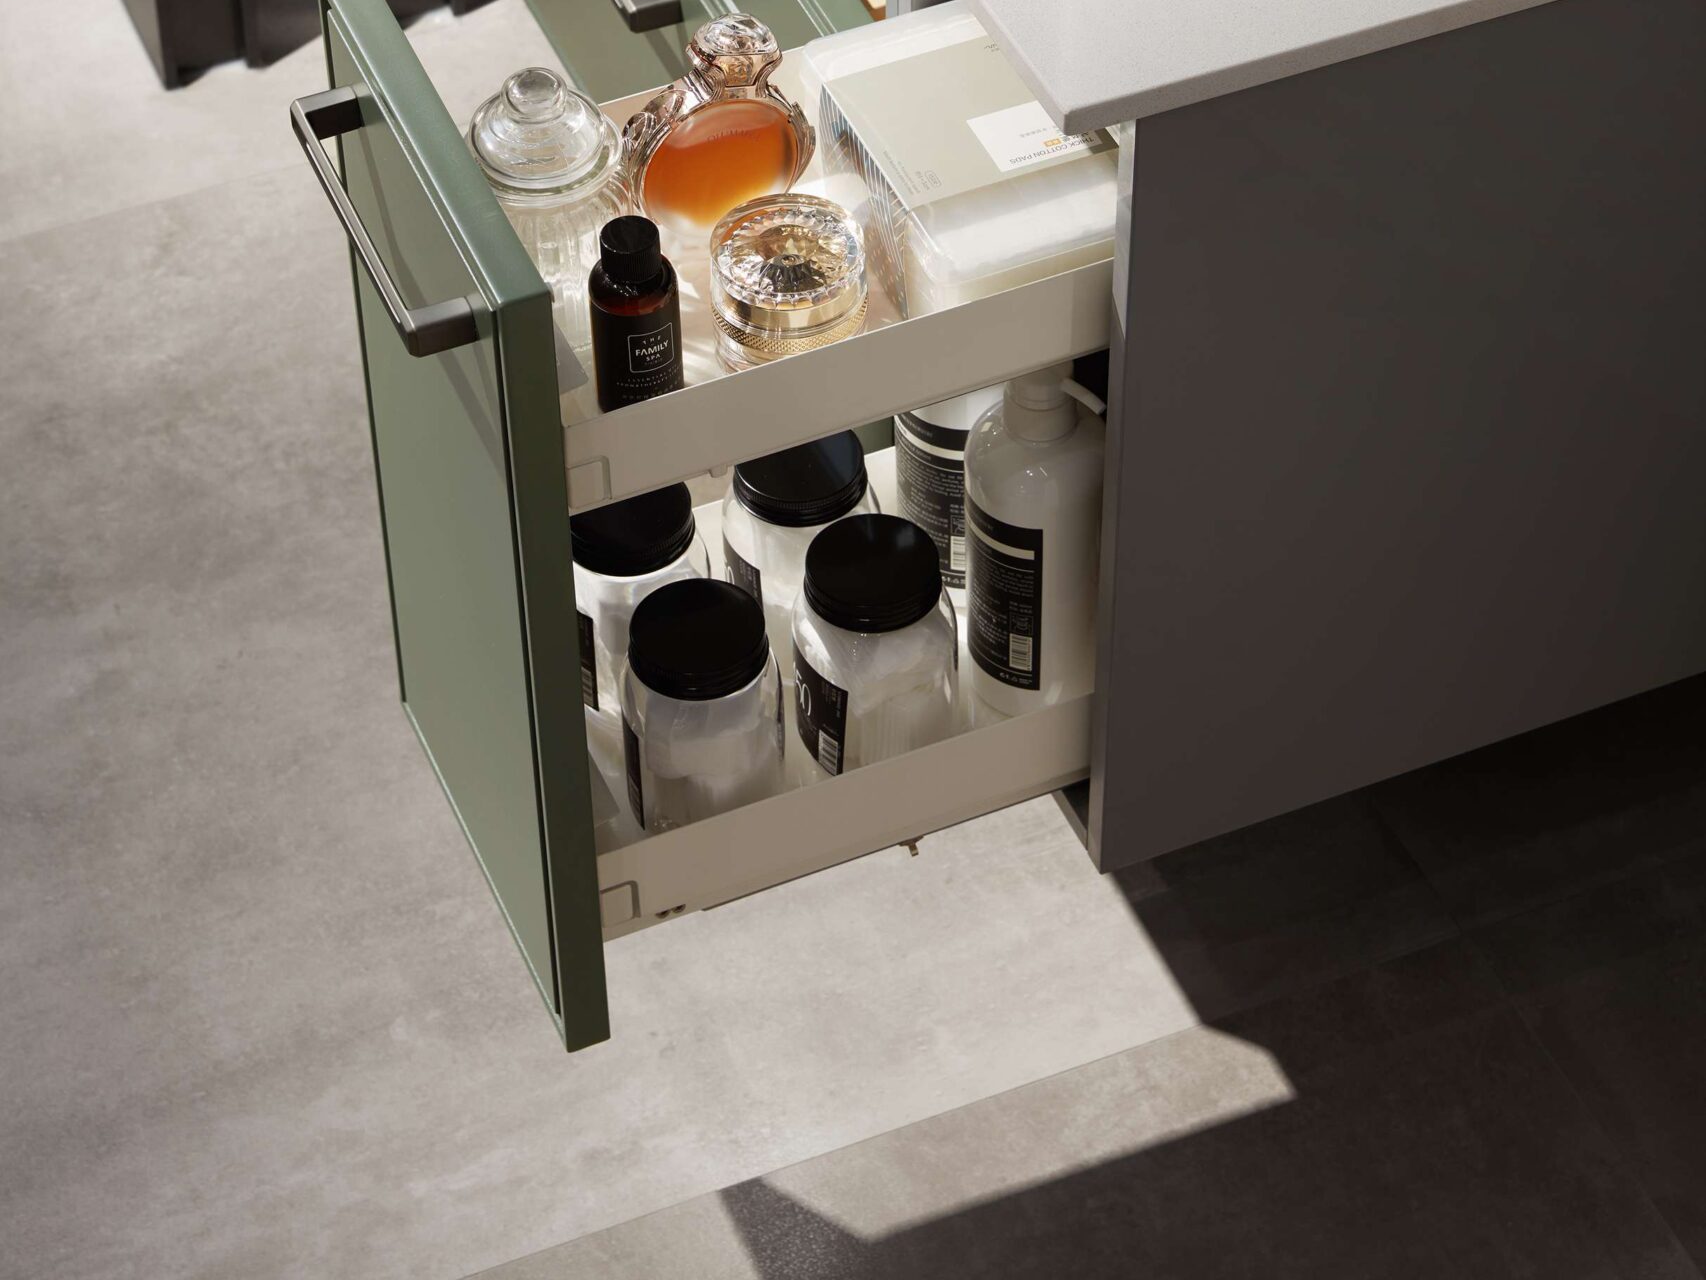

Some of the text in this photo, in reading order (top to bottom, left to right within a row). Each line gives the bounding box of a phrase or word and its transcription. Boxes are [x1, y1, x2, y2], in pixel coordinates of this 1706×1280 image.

[1070, 136, 1095, 148] THICK
[1034, 143, 1068, 158] COTTON
[1009, 154, 1033, 164] PADS
[635, 340, 669, 357] FAMILY
[646, 353, 661, 361] SPA
